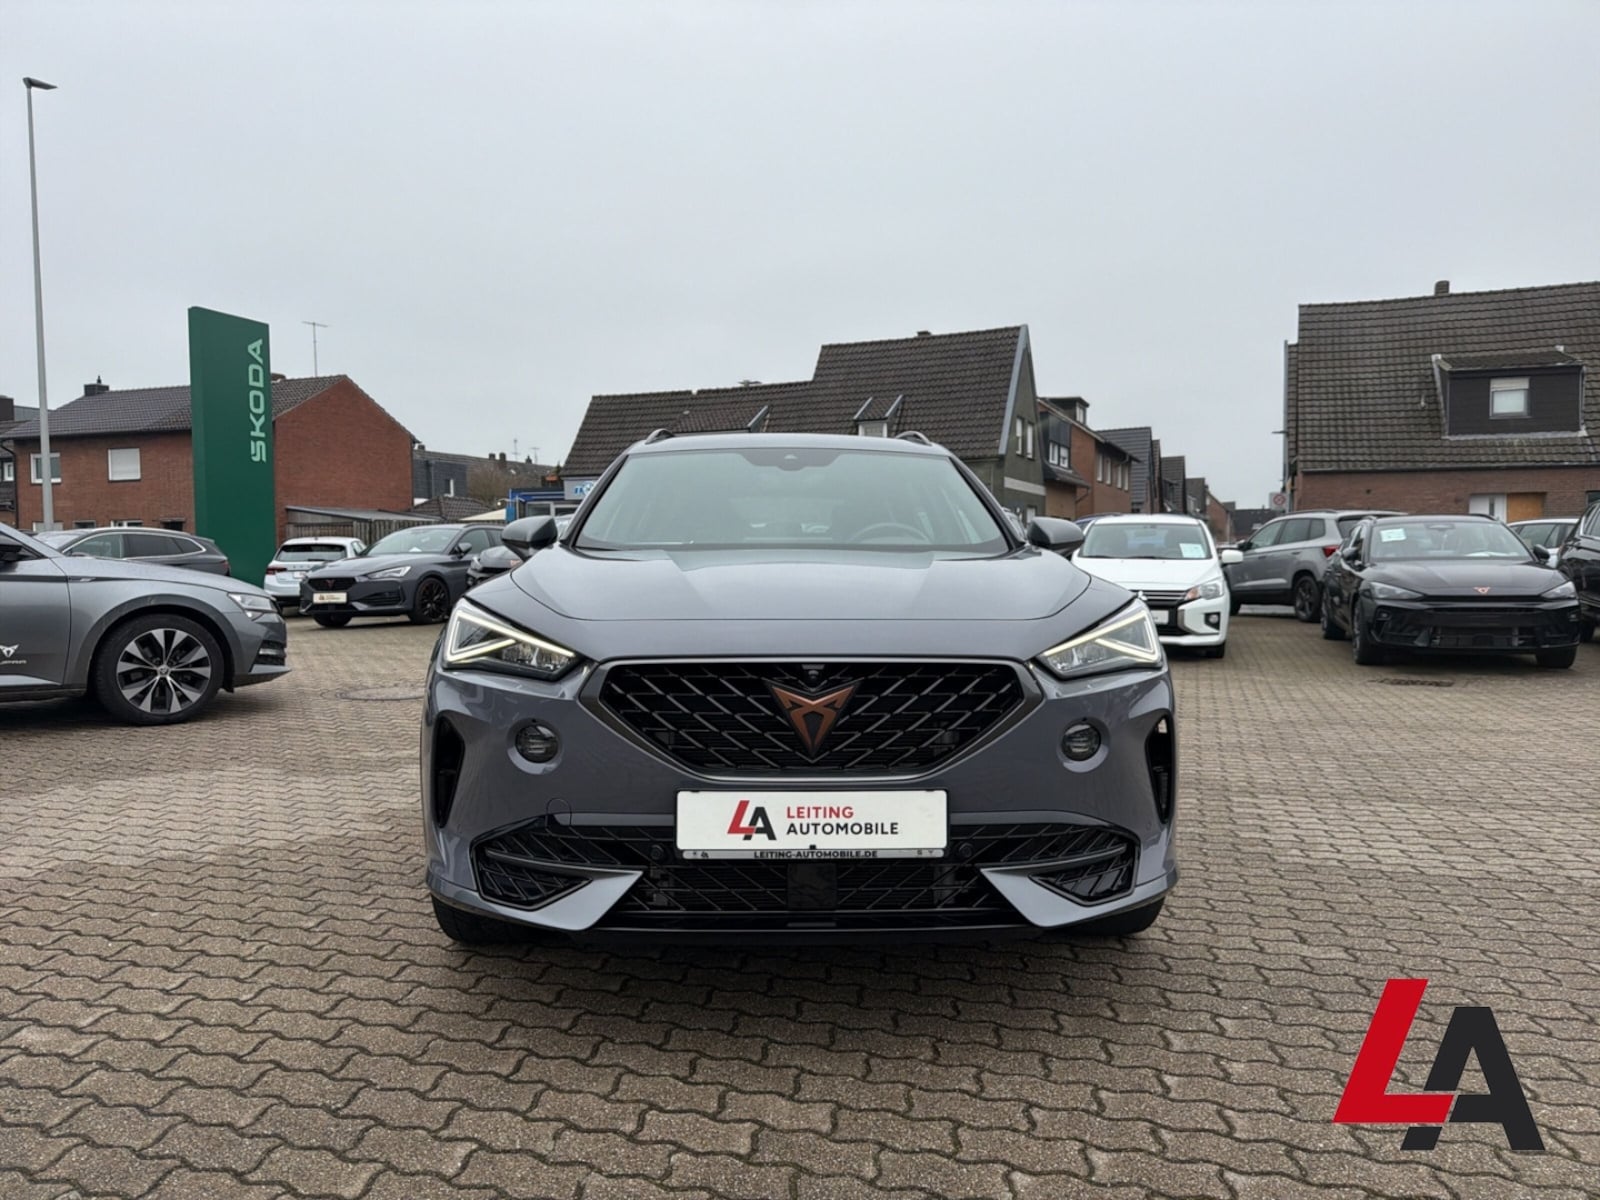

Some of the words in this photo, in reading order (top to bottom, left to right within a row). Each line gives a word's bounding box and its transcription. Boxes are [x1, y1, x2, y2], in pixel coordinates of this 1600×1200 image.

[787, 806, 854, 819] LEITING
[727, 800, 777, 841] LA
[786, 822, 899, 836] AUTOMOBILE
[753, 850, 878, 859] LEITING-AUTOMOBILE.DE
